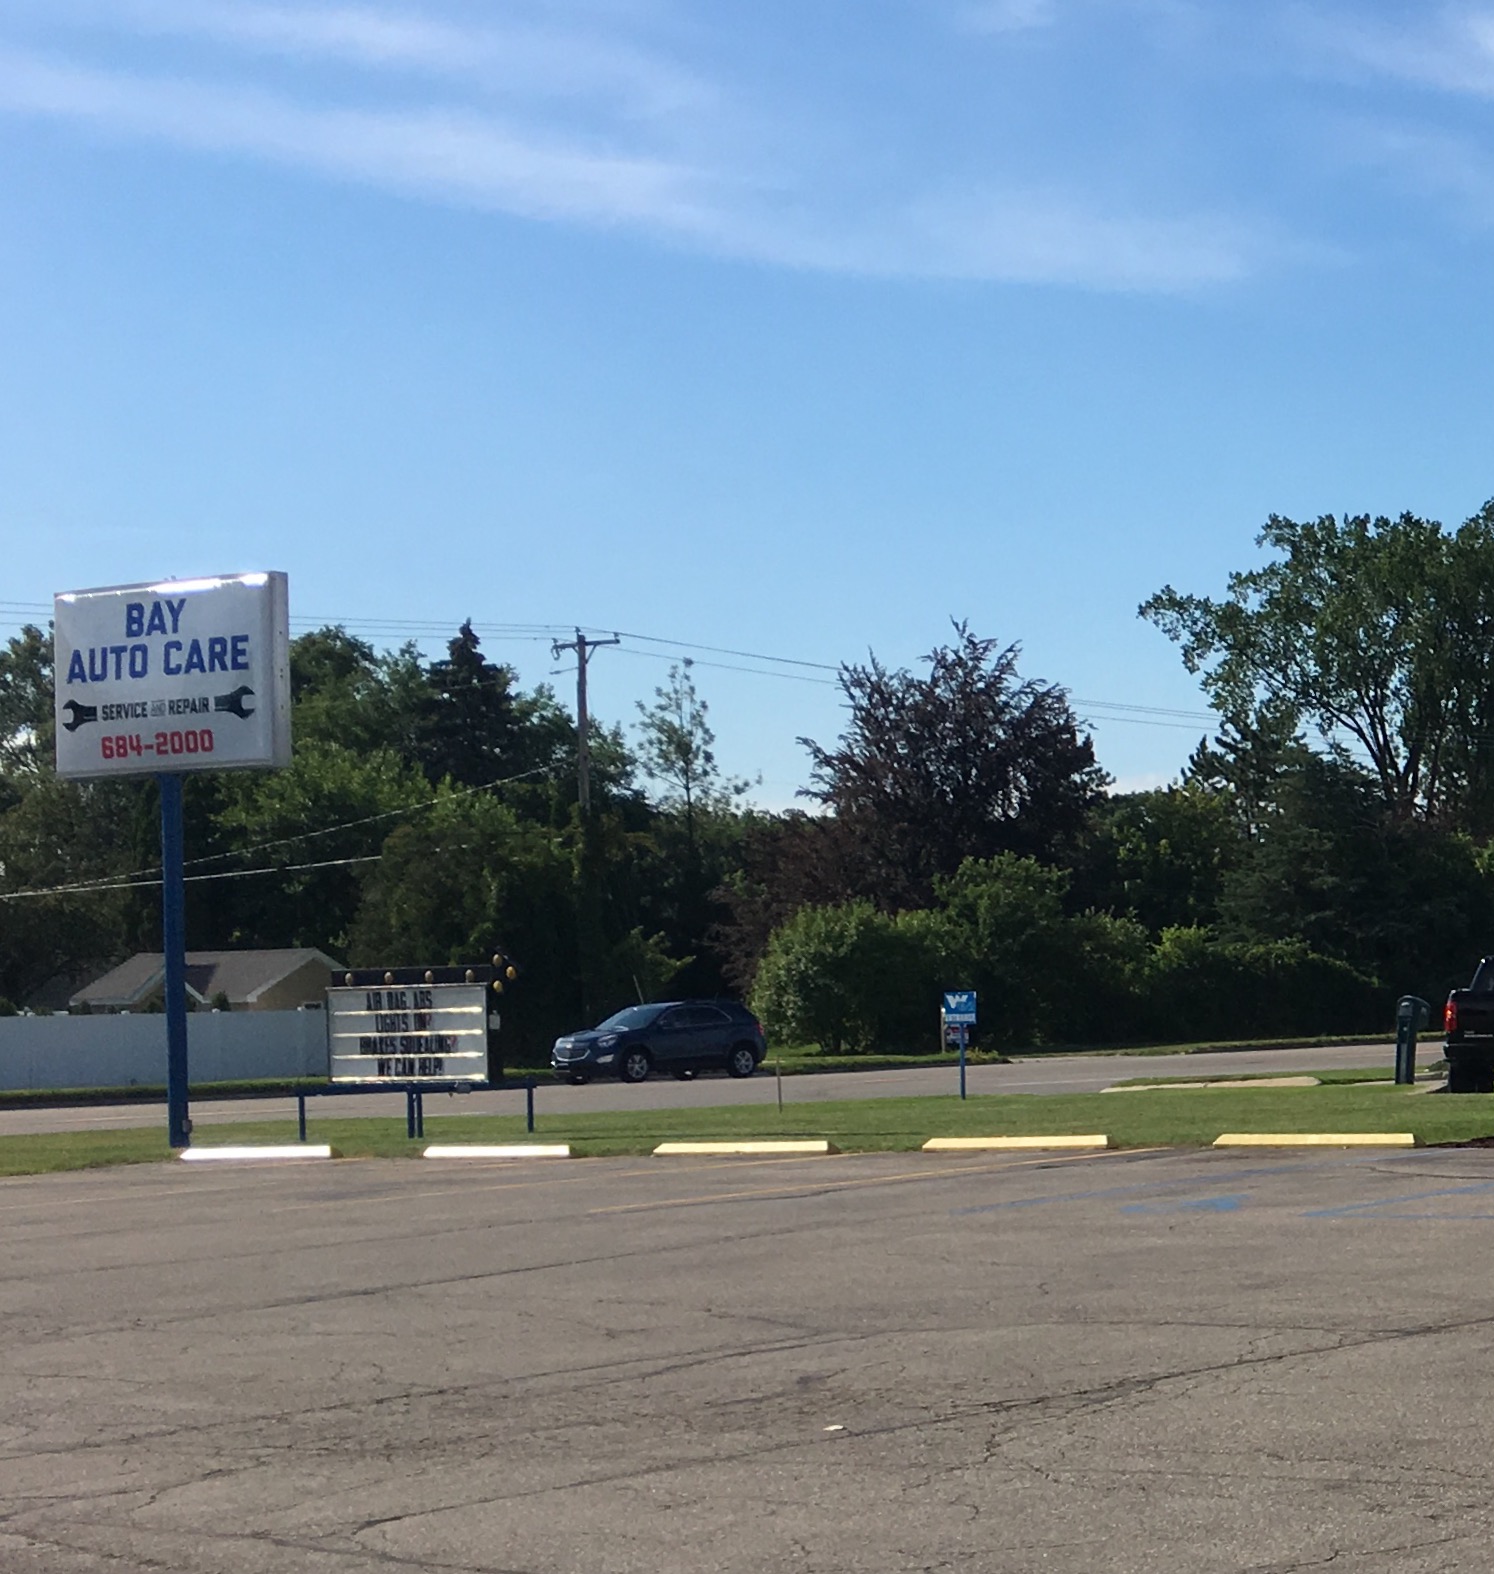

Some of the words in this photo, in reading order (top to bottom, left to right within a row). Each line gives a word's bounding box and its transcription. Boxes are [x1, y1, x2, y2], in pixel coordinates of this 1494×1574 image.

[126, 598, 187, 638] BAY
[66, 643, 149, 685] AUTO
[163, 634, 250, 676] CARE
[102, 701, 148, 721] SERVICE
[151, 700, 166, 717] AND
[168, 697, 210, 715] REPAIR
[101, 728, 214, 760] 684-2000
[366, 991, 382, 1011] AIR
[413, 990, 433, 1010] ABS
[395, 1057, 415, 1076] CAN
